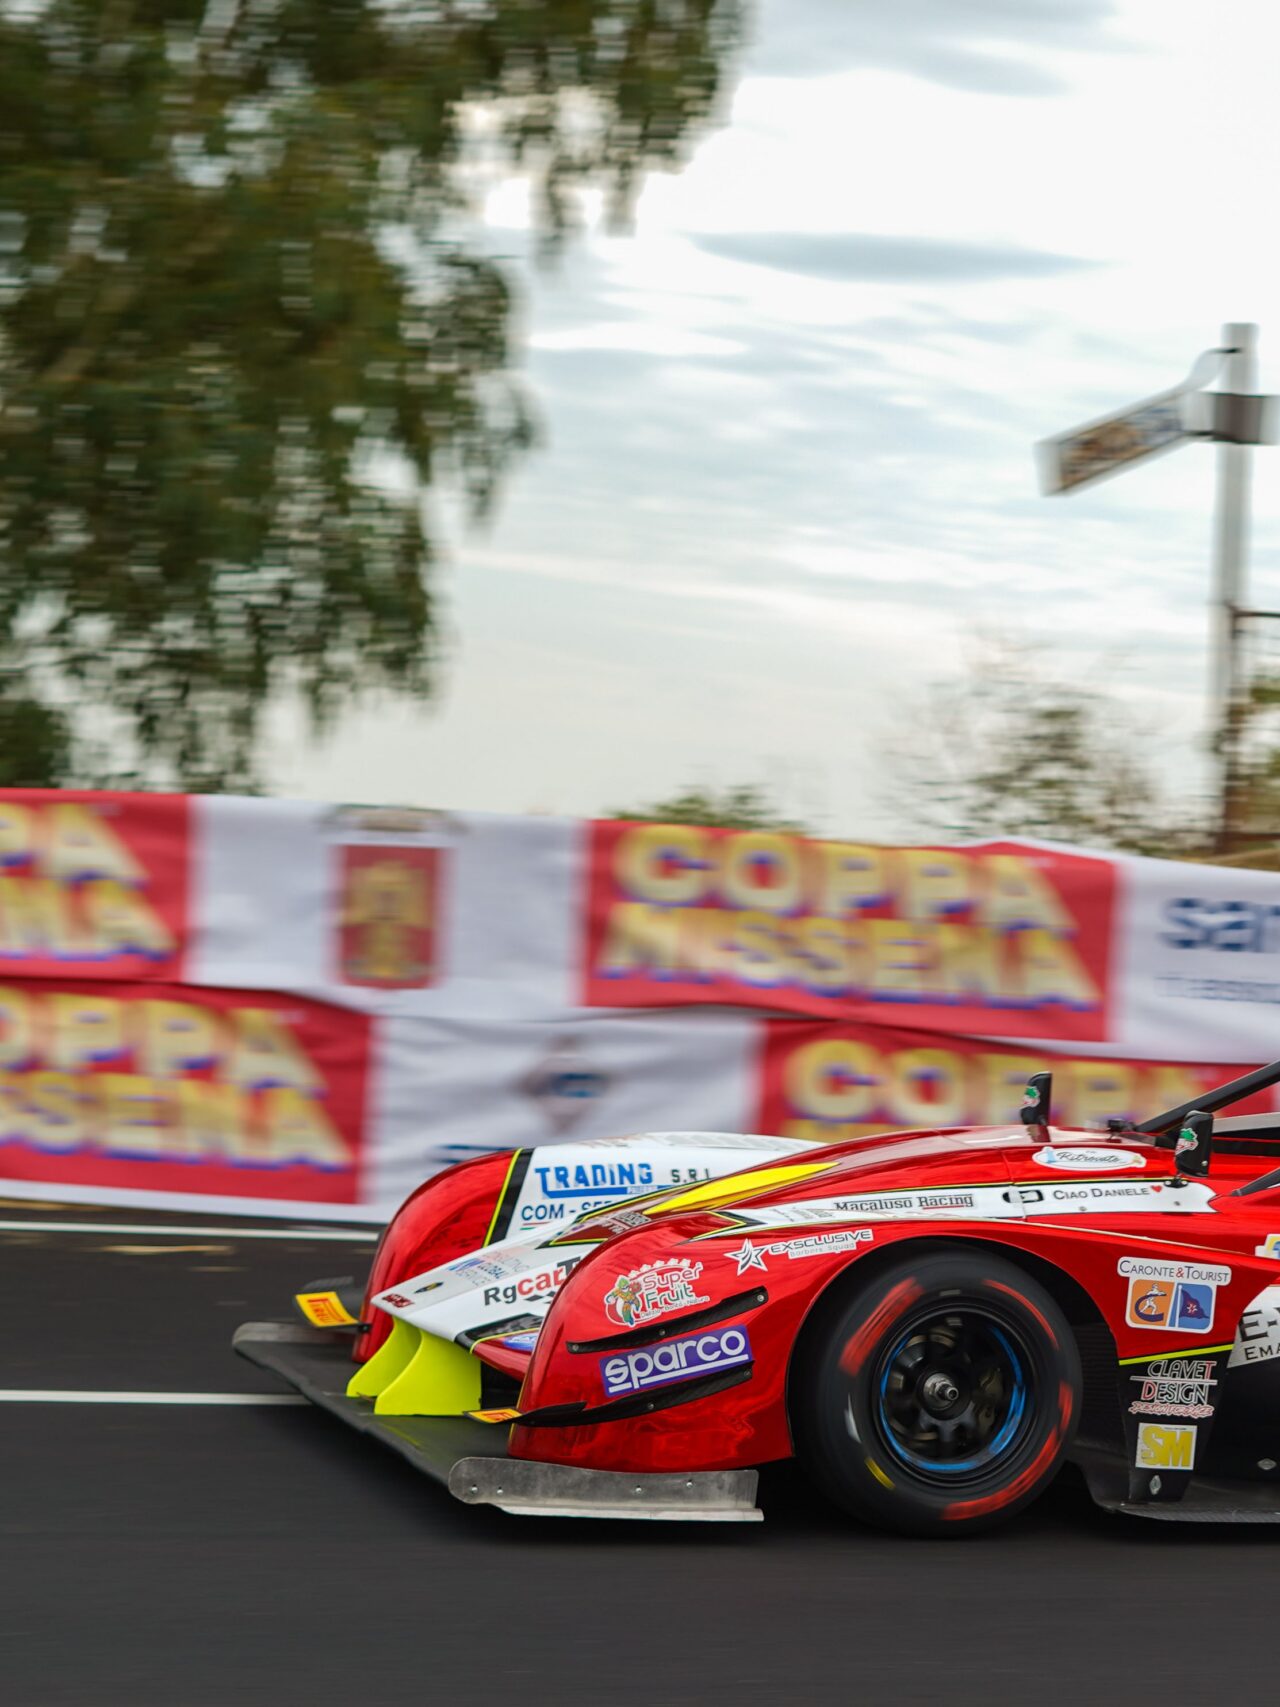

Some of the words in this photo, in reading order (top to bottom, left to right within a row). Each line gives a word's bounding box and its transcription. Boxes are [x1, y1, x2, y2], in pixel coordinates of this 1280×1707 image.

[610, 823, 1080, 935] COPPA
[834, 1197, 914, 1212] Macaluso
[918, 1194, 975, 1209] Racing
[1090, 1186, 1150, 1199] DANIELE
[521, 1204, 564, 1221] COM
[771, 1231, 871, 1253] EXSCLUSIVE
[828, 1242, 855, 1253] Squad
[643, 1263, 701, 1291] Super
[645, 1284, 694, 1309] Fruit
[604, 1330, 746, 1389] sparco
[1148, 1360, 1217, 1380] CLAVET
[1141, 1381, 1208, 1404] DESIGN
[1140, 1426, 1194, 1467] SM
